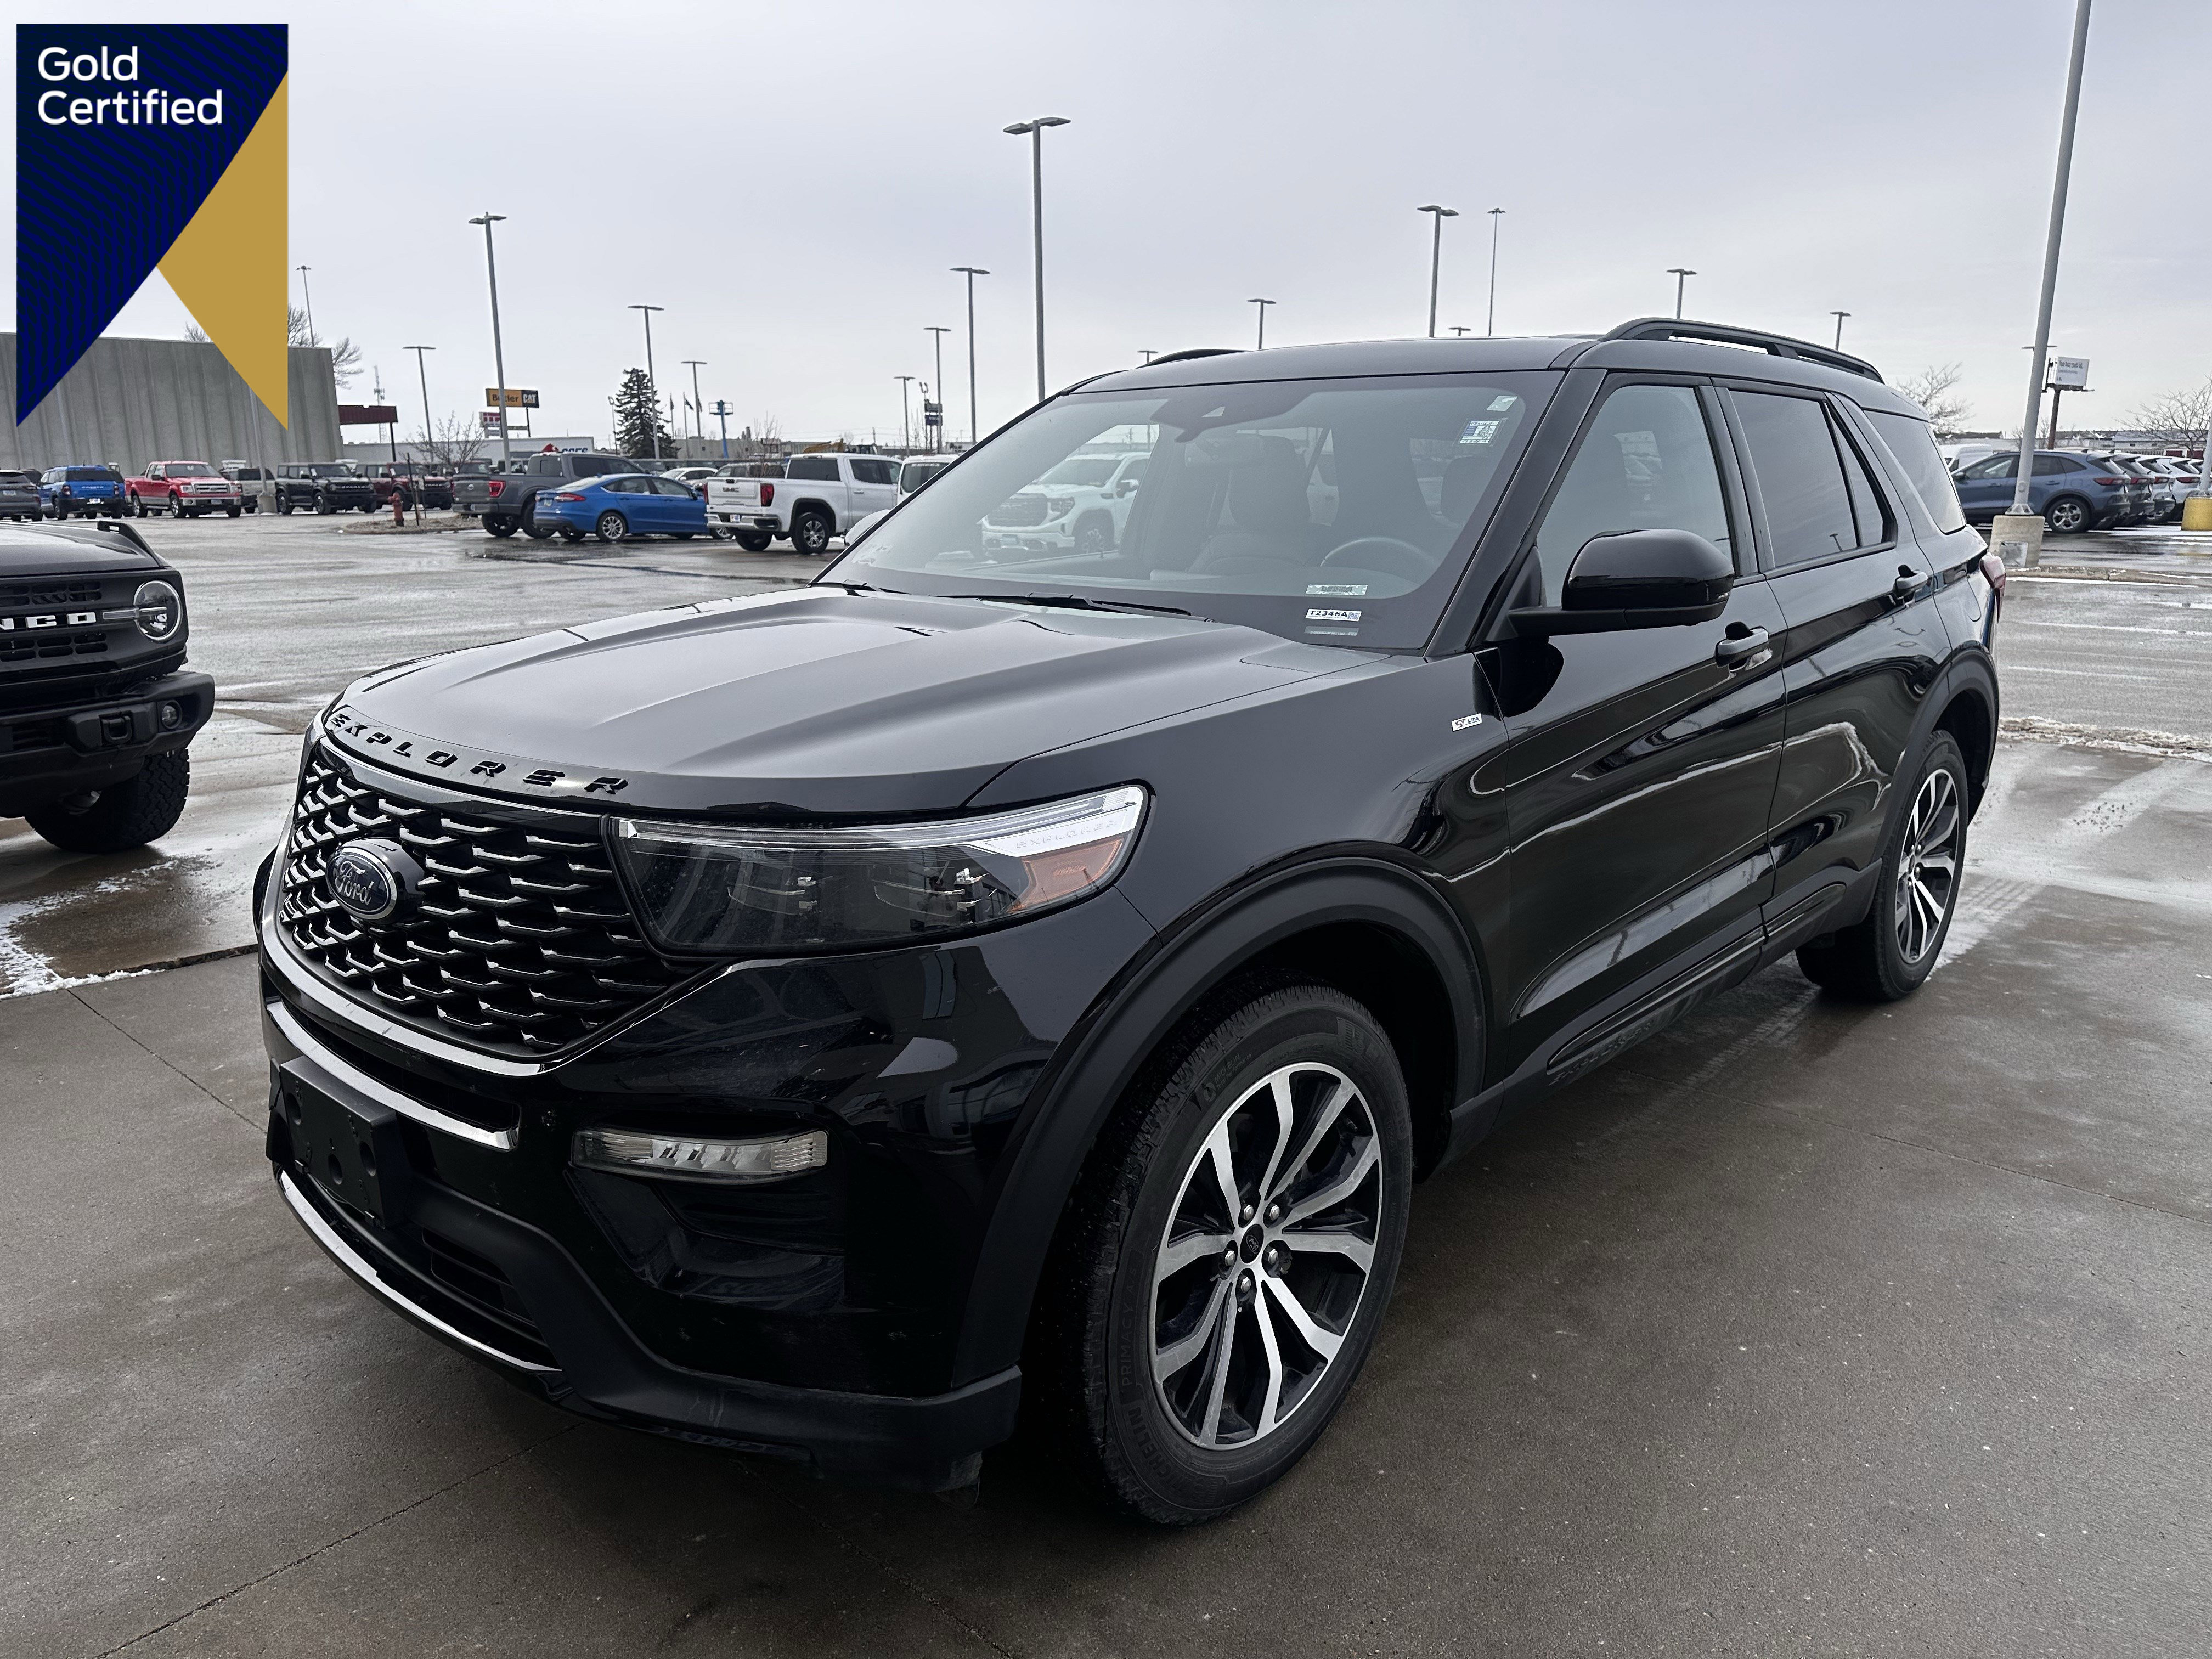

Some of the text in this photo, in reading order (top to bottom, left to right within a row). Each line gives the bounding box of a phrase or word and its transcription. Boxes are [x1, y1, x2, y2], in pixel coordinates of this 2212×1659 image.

[492, 393, 537, 404] Bler CAT
[330, 713, 629, 795] EXPLORER
[1015, 820, 1118, 849] EXPLORER
[335, 860, 375, 906] Ford
[1120, 1302, 1134, 1387] PRIMACY
[1128, 1406, 1188, 1496] MICHELIN
